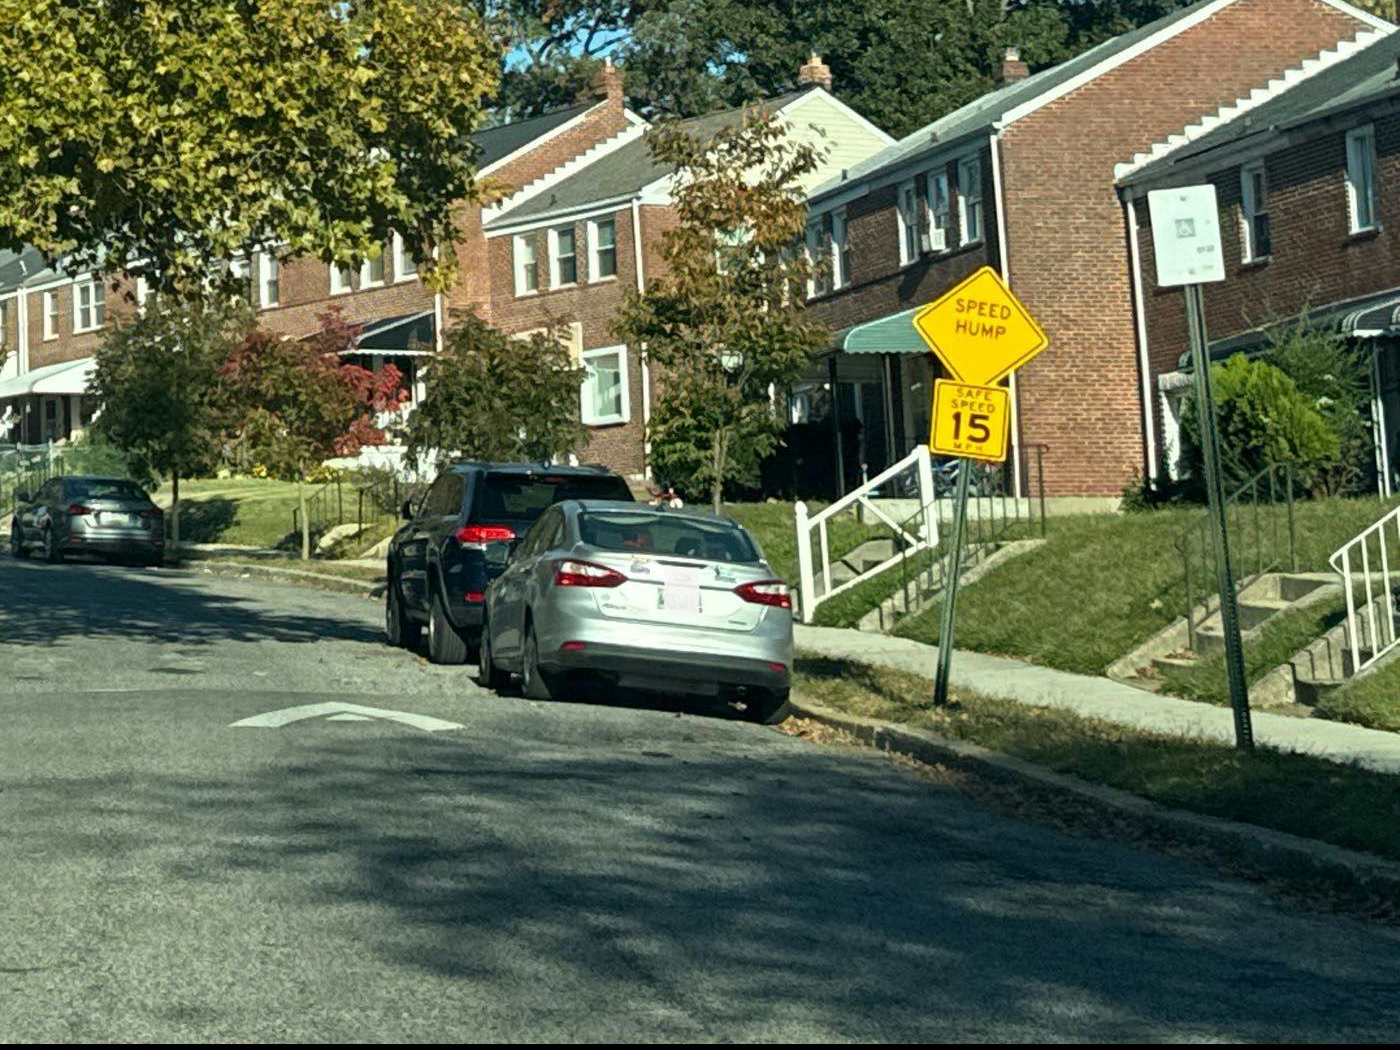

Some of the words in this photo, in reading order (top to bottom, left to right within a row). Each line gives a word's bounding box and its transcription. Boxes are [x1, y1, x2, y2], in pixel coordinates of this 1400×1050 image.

[955, 298, 1011, 320] SPEED
[955, 319, 1006, 339] HUMP
[956, 388, 992, 401] SAFE
[951, 399, 996, 414] SPEED
[952, 411, 991, 443] 15
